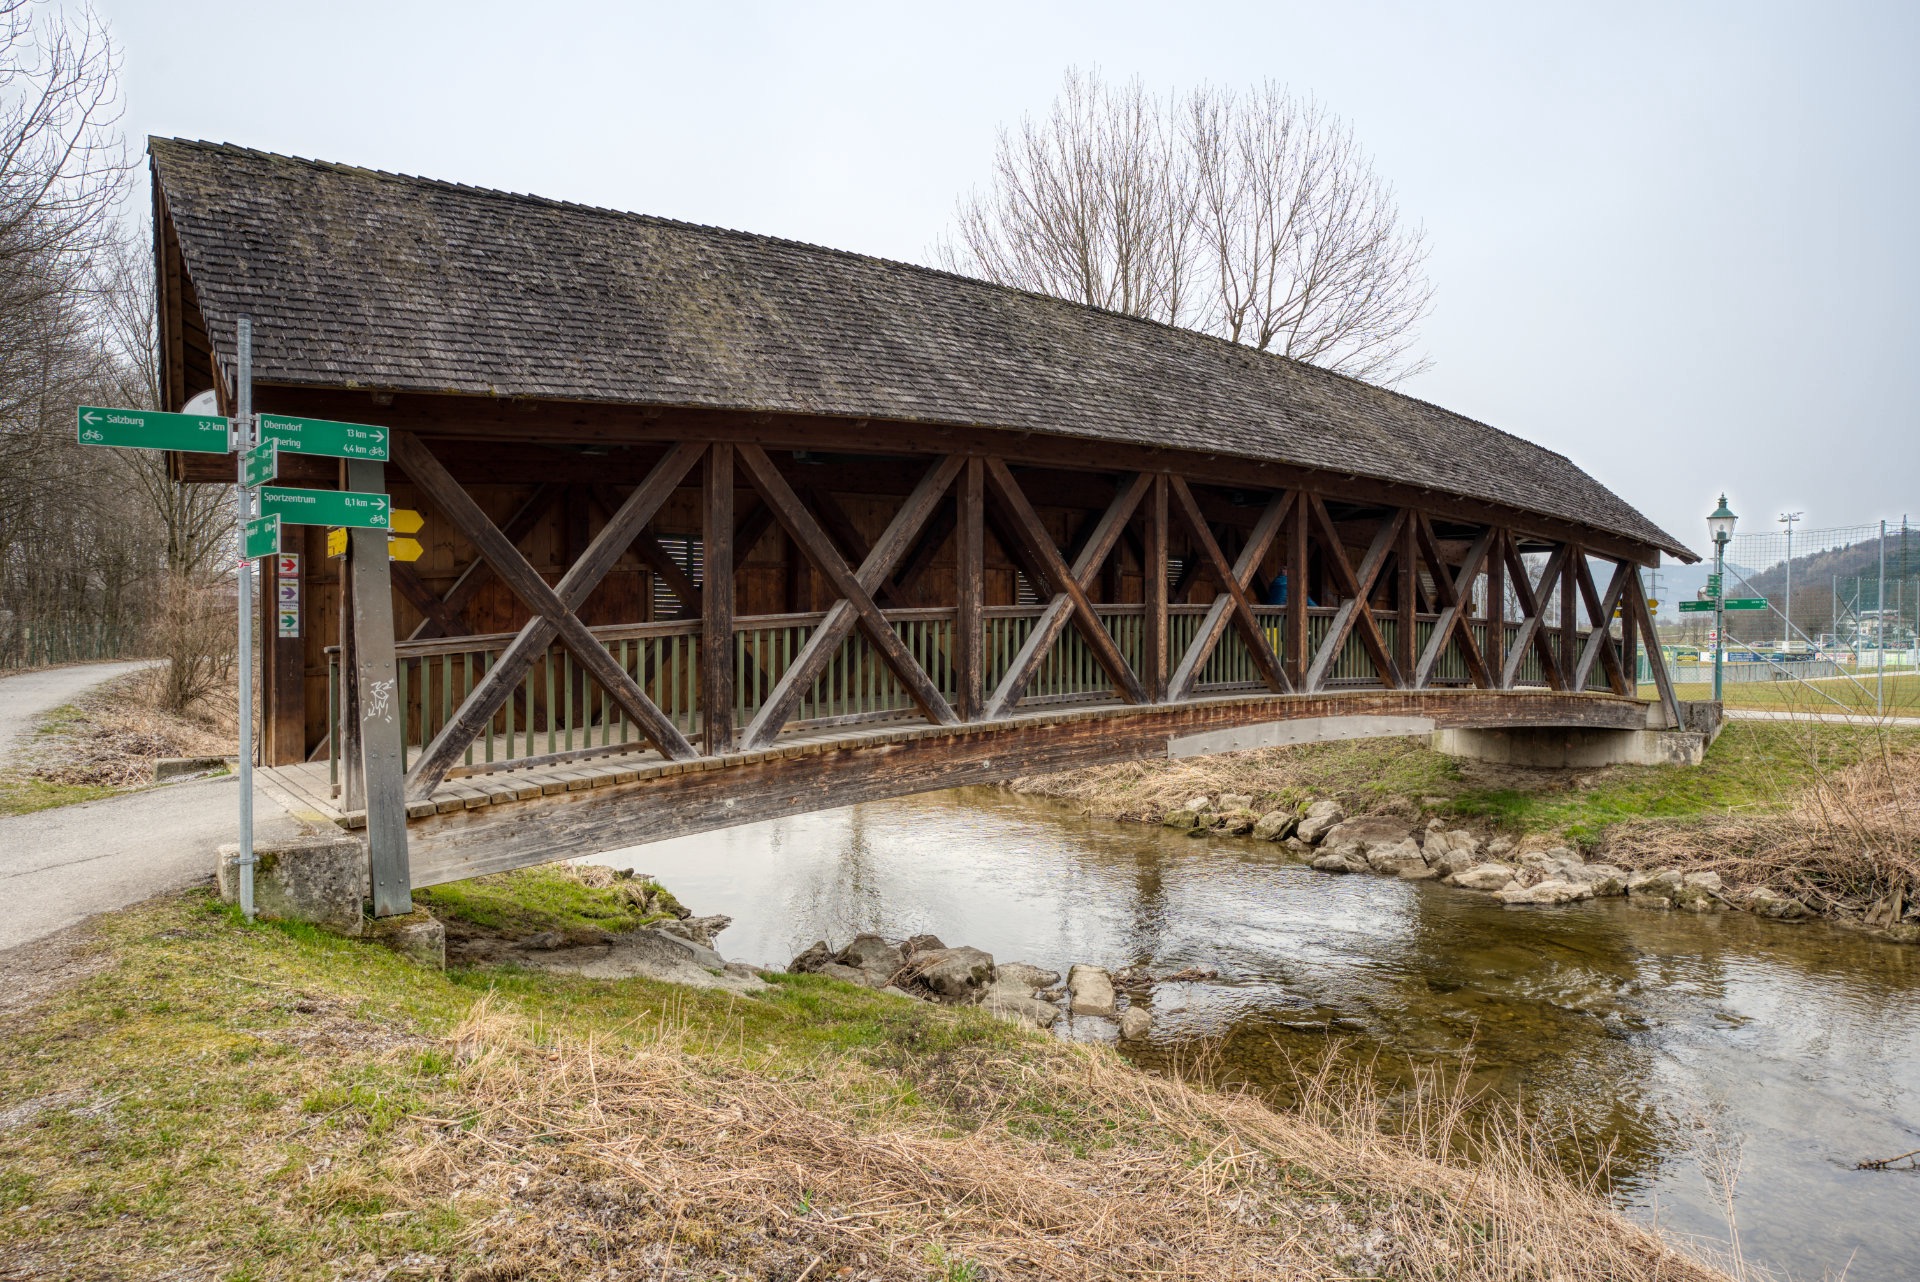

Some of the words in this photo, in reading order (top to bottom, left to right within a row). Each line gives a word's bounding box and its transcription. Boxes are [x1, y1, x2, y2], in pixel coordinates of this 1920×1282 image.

[106, 414, 144, 427] Salzburg
[198, 422, 210, 431] 5,2
[212, 422, 225, 431] km
[264, 420, 302, 431] Oberndorf
[346, 429, 354, 437] 13
[355, 430, 367, 438] km
[343, 444, 354, 453] 4,4
[355, 445, 367, 453] km
[264, 492, 316, 503] Sportzentrum
[345, 498, 355, 507] 0,1
[357, 499, 368, 507] km
